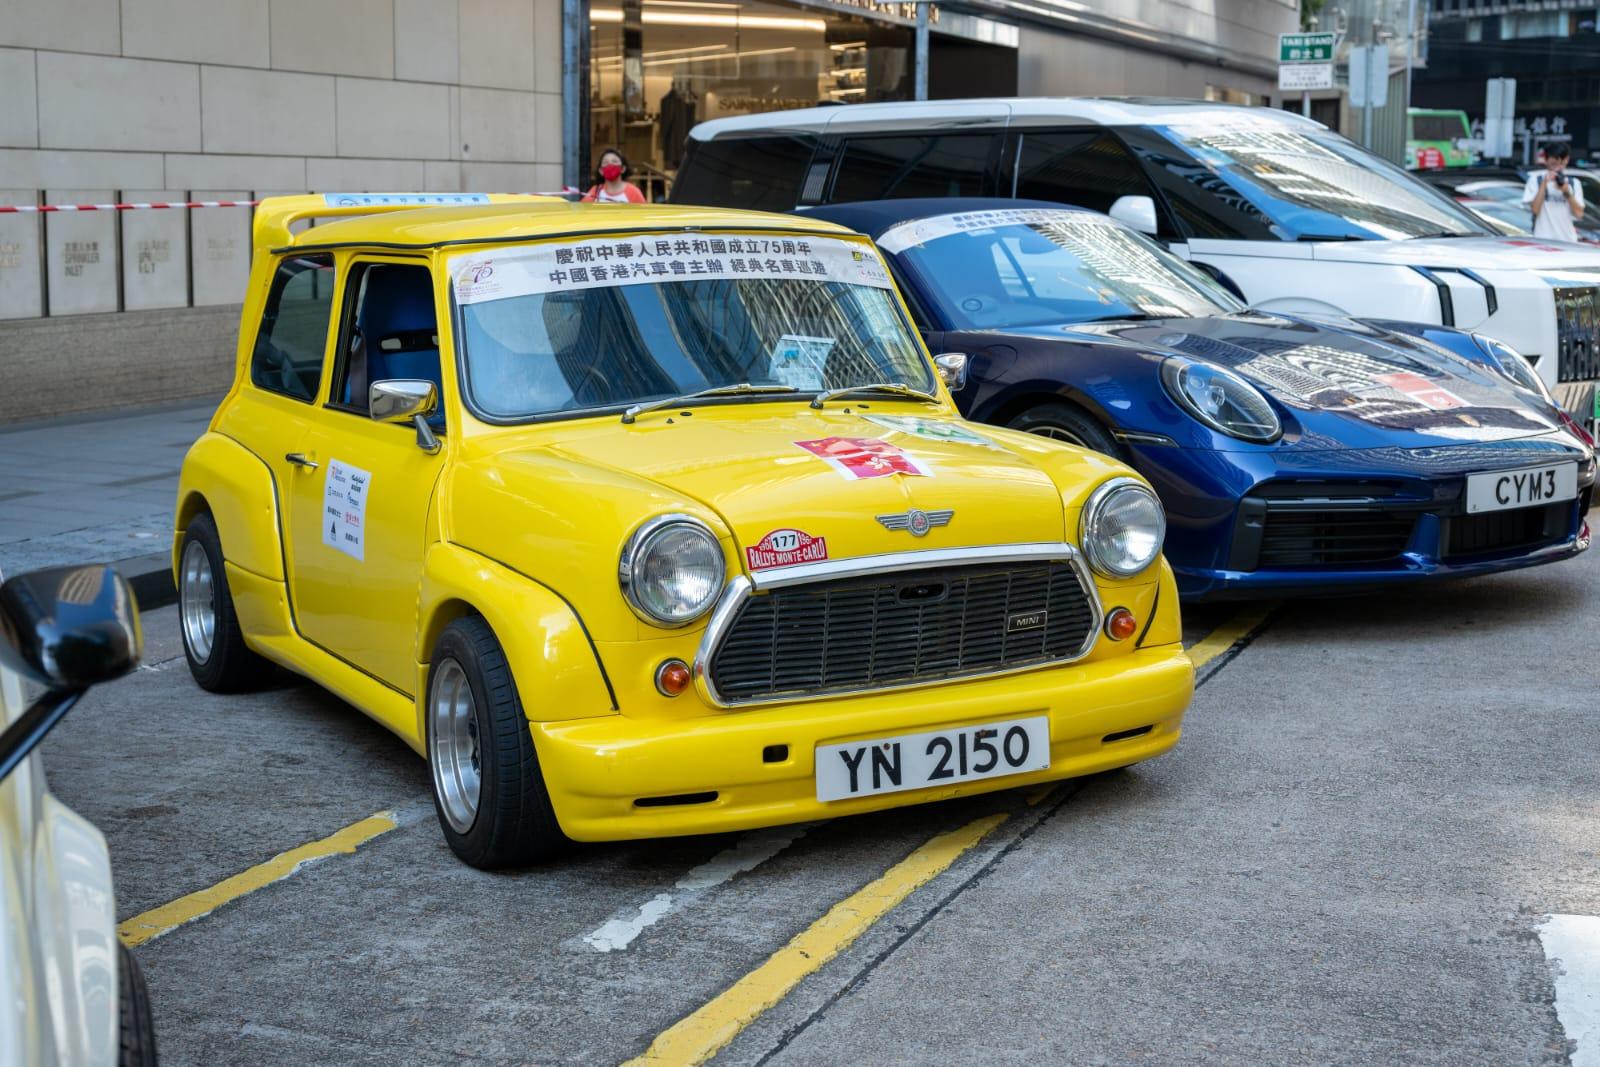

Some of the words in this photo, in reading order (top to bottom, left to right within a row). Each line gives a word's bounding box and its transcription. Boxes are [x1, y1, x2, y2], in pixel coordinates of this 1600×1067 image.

[1282, 37, 1303, 46] TAXI
[1304, 36, 1333, 46] STAND
[555, 238, 812, 265] 慶祝中華人民共和國成立75周年
[549, 257, 724, 285] 中國香港汽車會主辦
[1495, 470, 1556, 505] CYM3
[772, 534, 796, 548] 177
[749, 548, 776, 568] RALLYE
[1016, 616, 1039, 626] MINI
[838, 742, 902, 793] YN
[925, 725, 1030, 781] 2150
